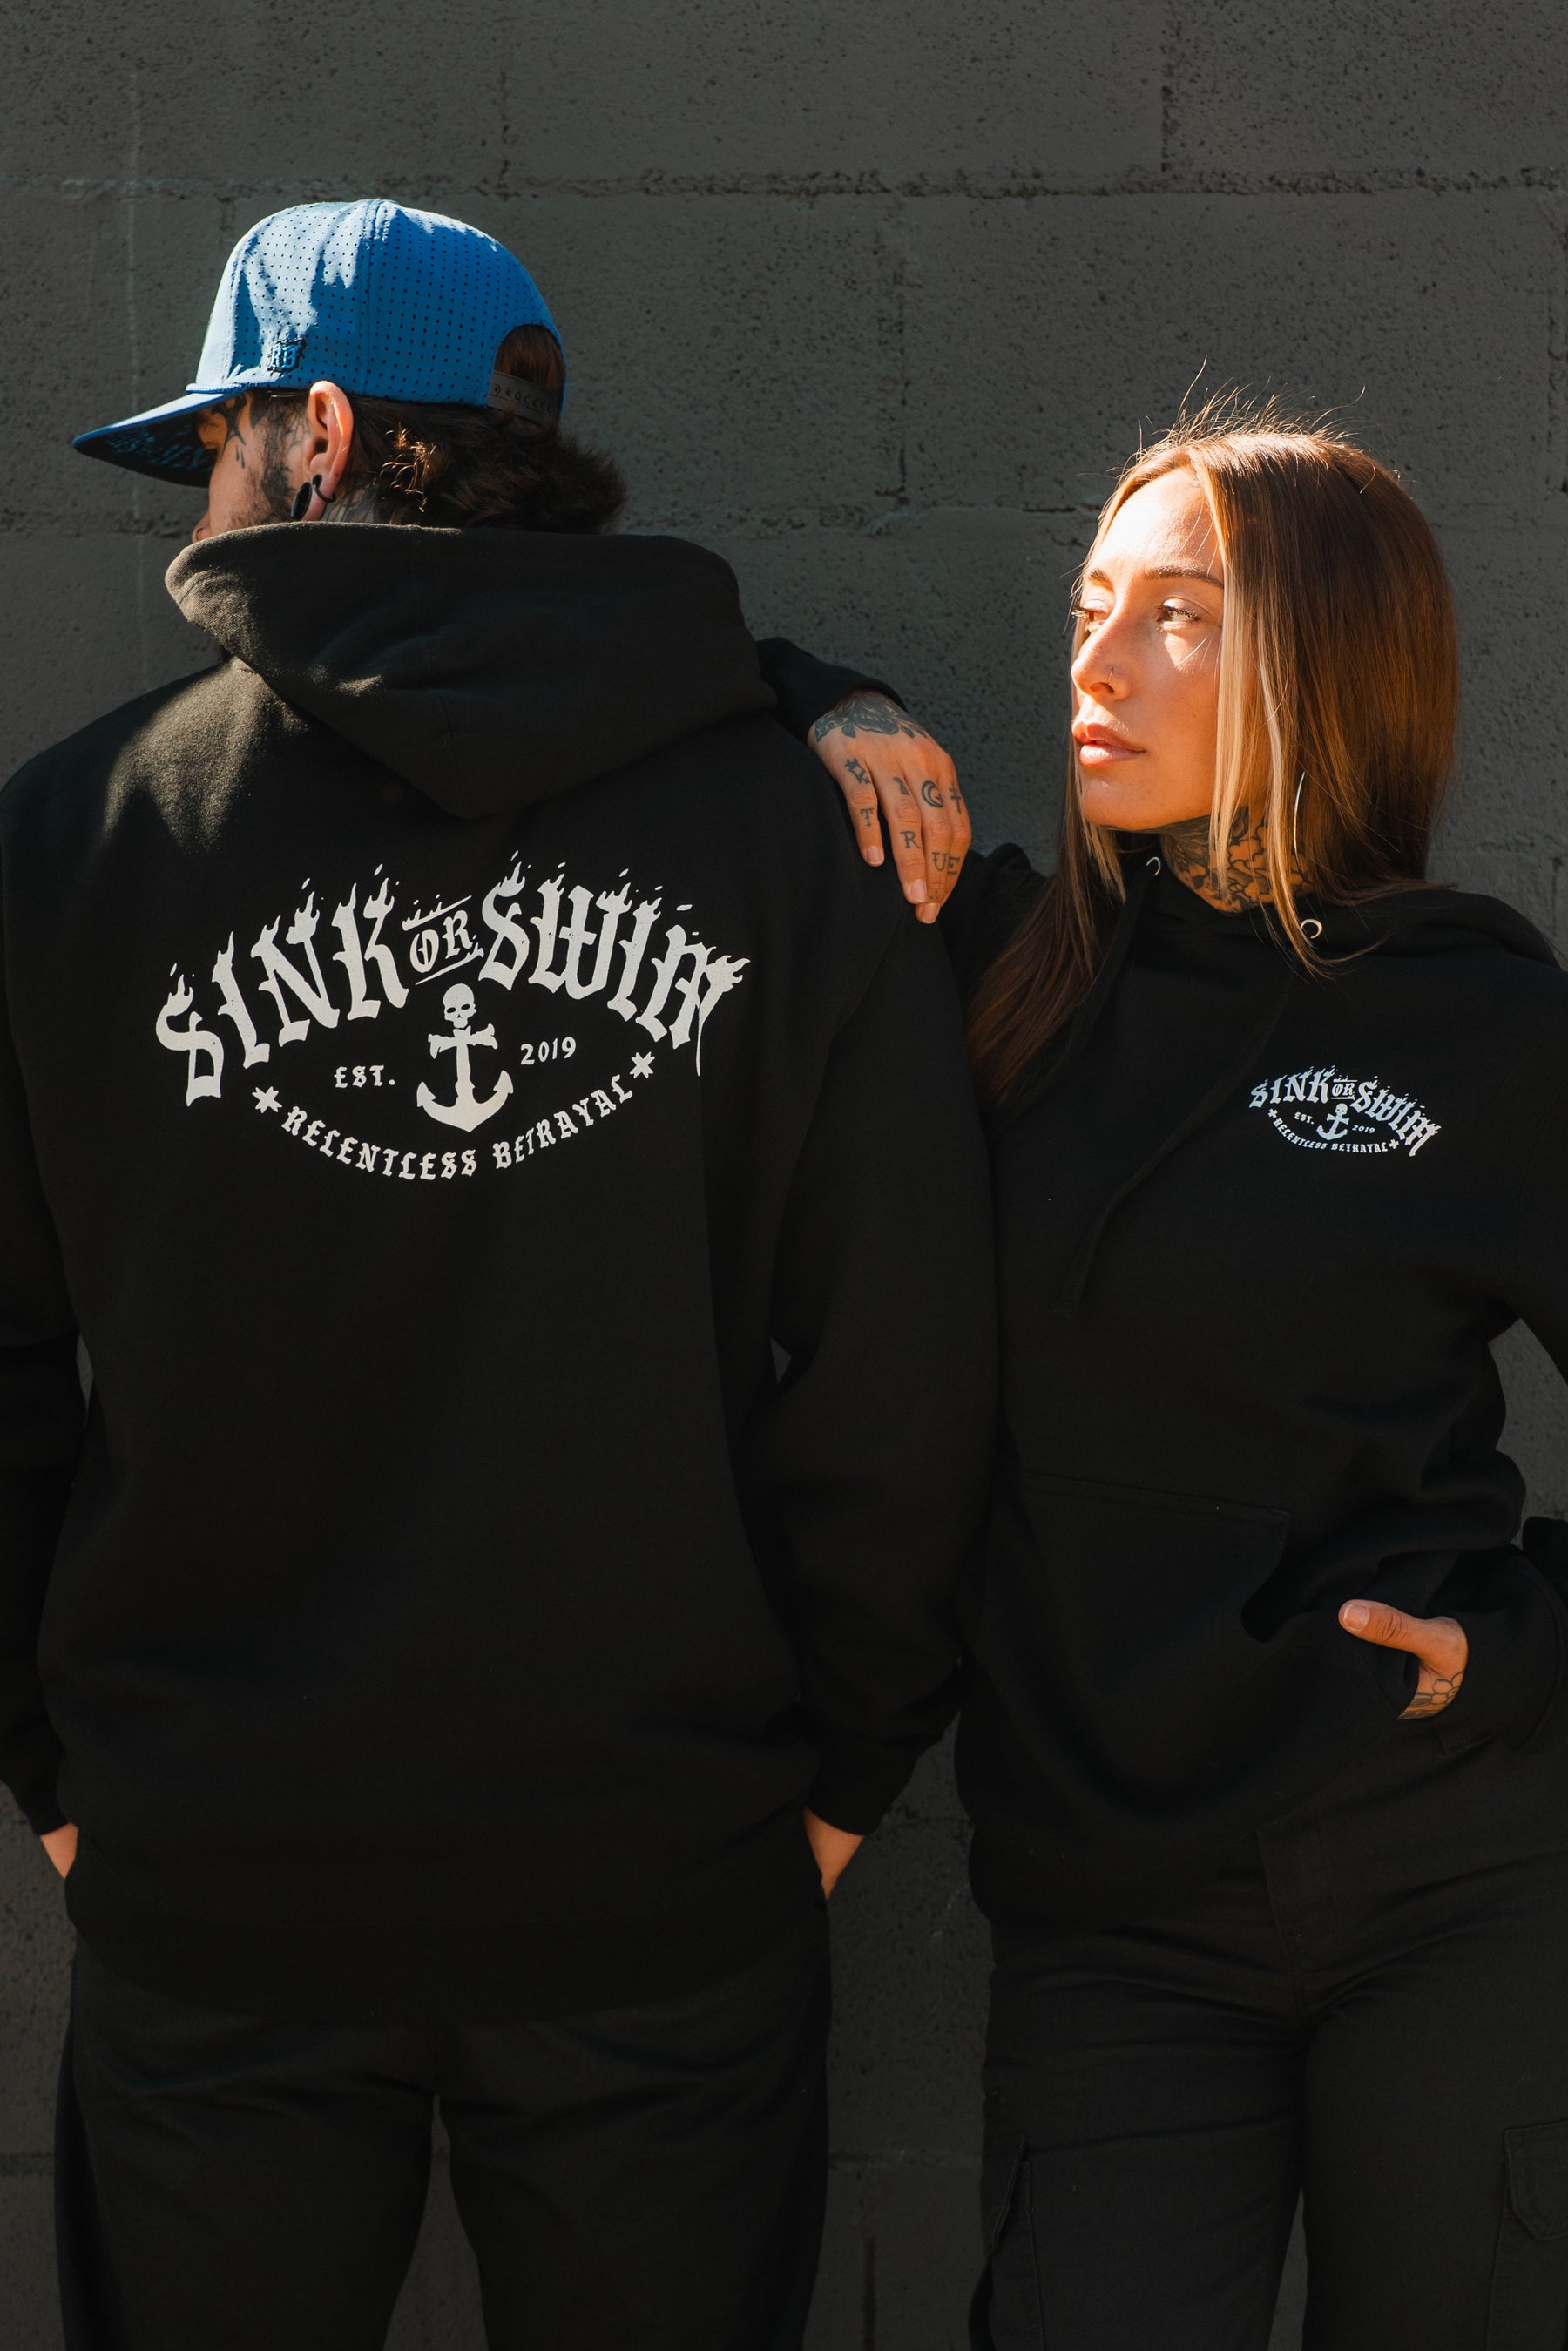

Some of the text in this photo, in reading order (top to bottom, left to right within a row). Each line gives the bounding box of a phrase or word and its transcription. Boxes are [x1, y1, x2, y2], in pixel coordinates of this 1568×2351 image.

[156, 858, 750, 1106] SINK OR SWIM
[334, 1037, 577, 1089] EST. 2019
[281, 1073, 633, 1181] RELENTLESS BETRAYAL
[1249, 1069, 1442, 1157] SINK OR SWIM
[1274, 1118, 1389, 1153] RELENTLESS BETRAYAL
[1294, 1111, 1376, 1134] EST. 2019
